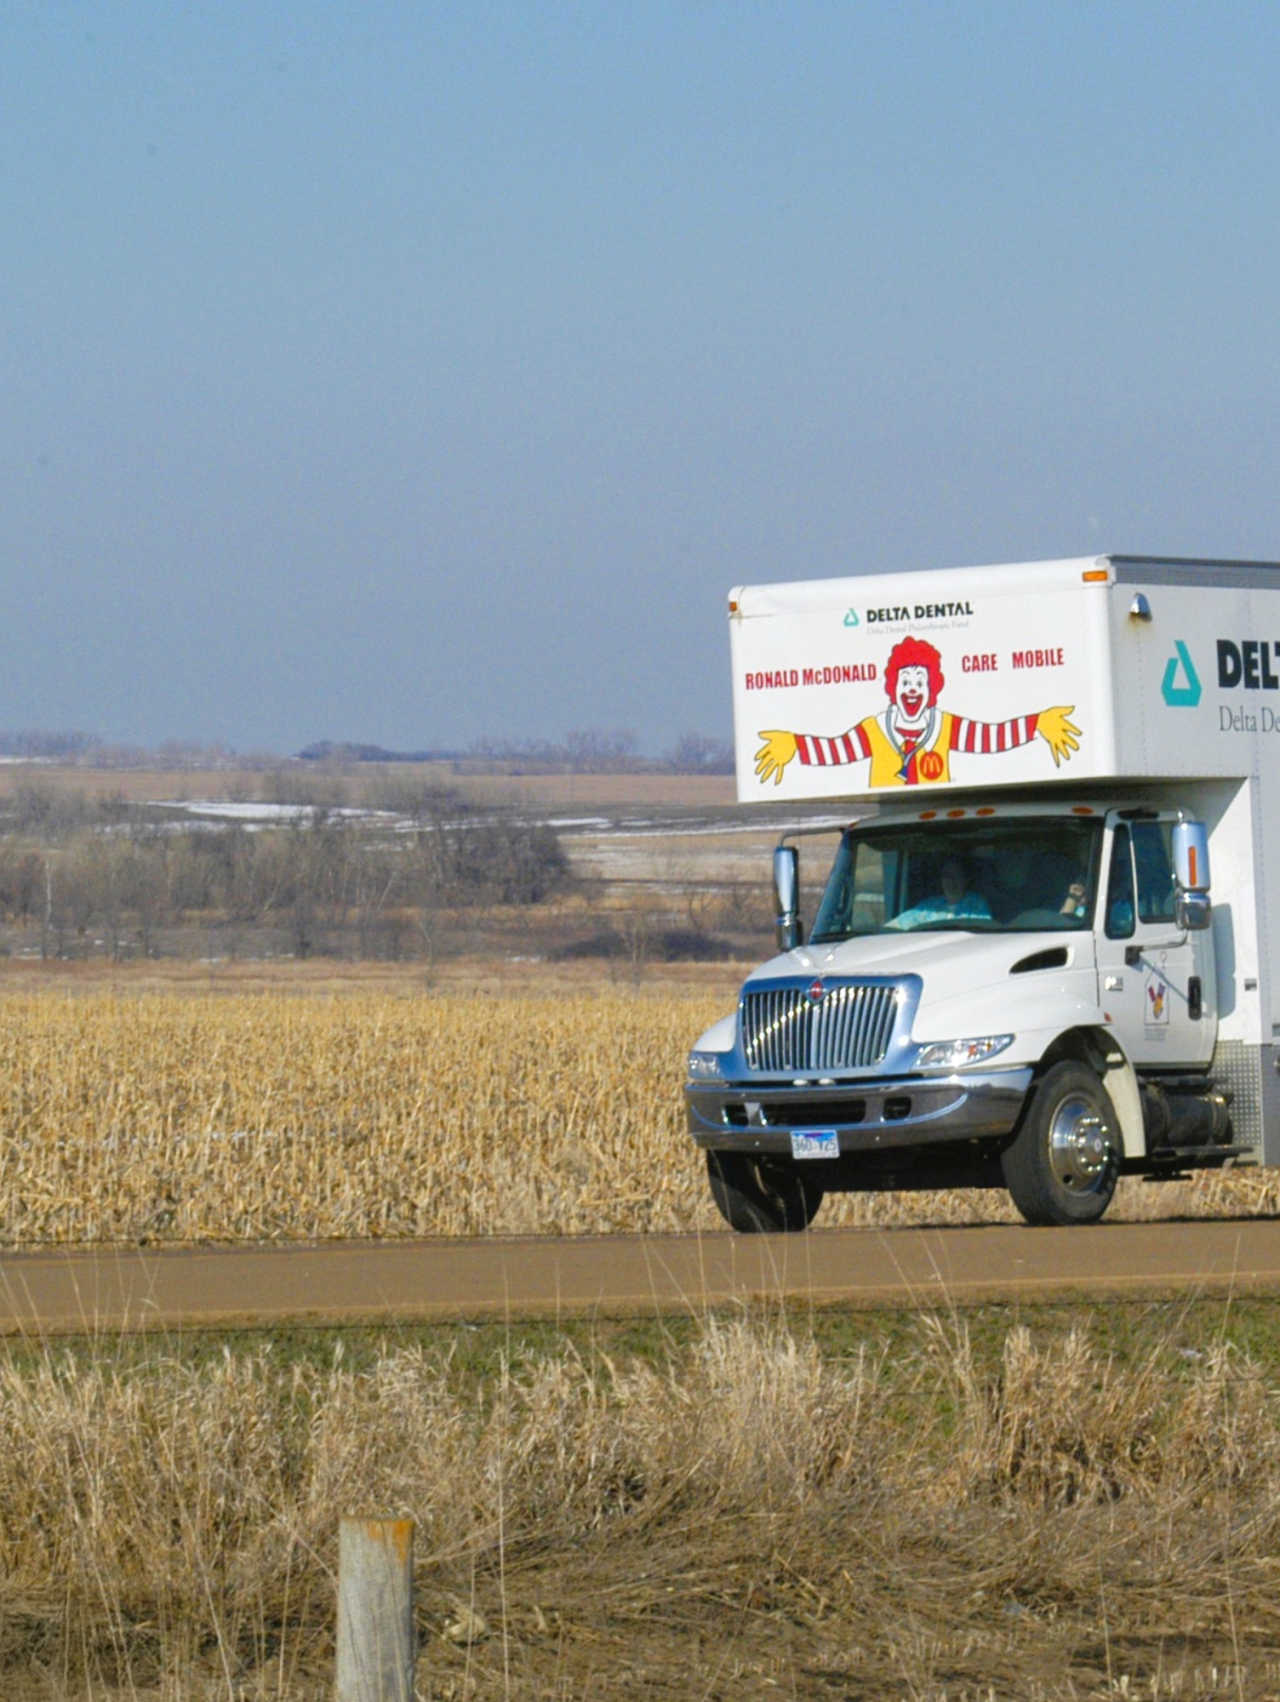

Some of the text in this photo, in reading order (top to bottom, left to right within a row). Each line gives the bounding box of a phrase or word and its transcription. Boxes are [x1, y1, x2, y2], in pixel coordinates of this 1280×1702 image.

[866, 601, 974, 623] DELTA DENTAL
[961, 648, 1065, 673] CARE MOBILE
[745, 663, 877, 690] RONALD McDONALD
[1219, 706, 1257, 732] Delta
